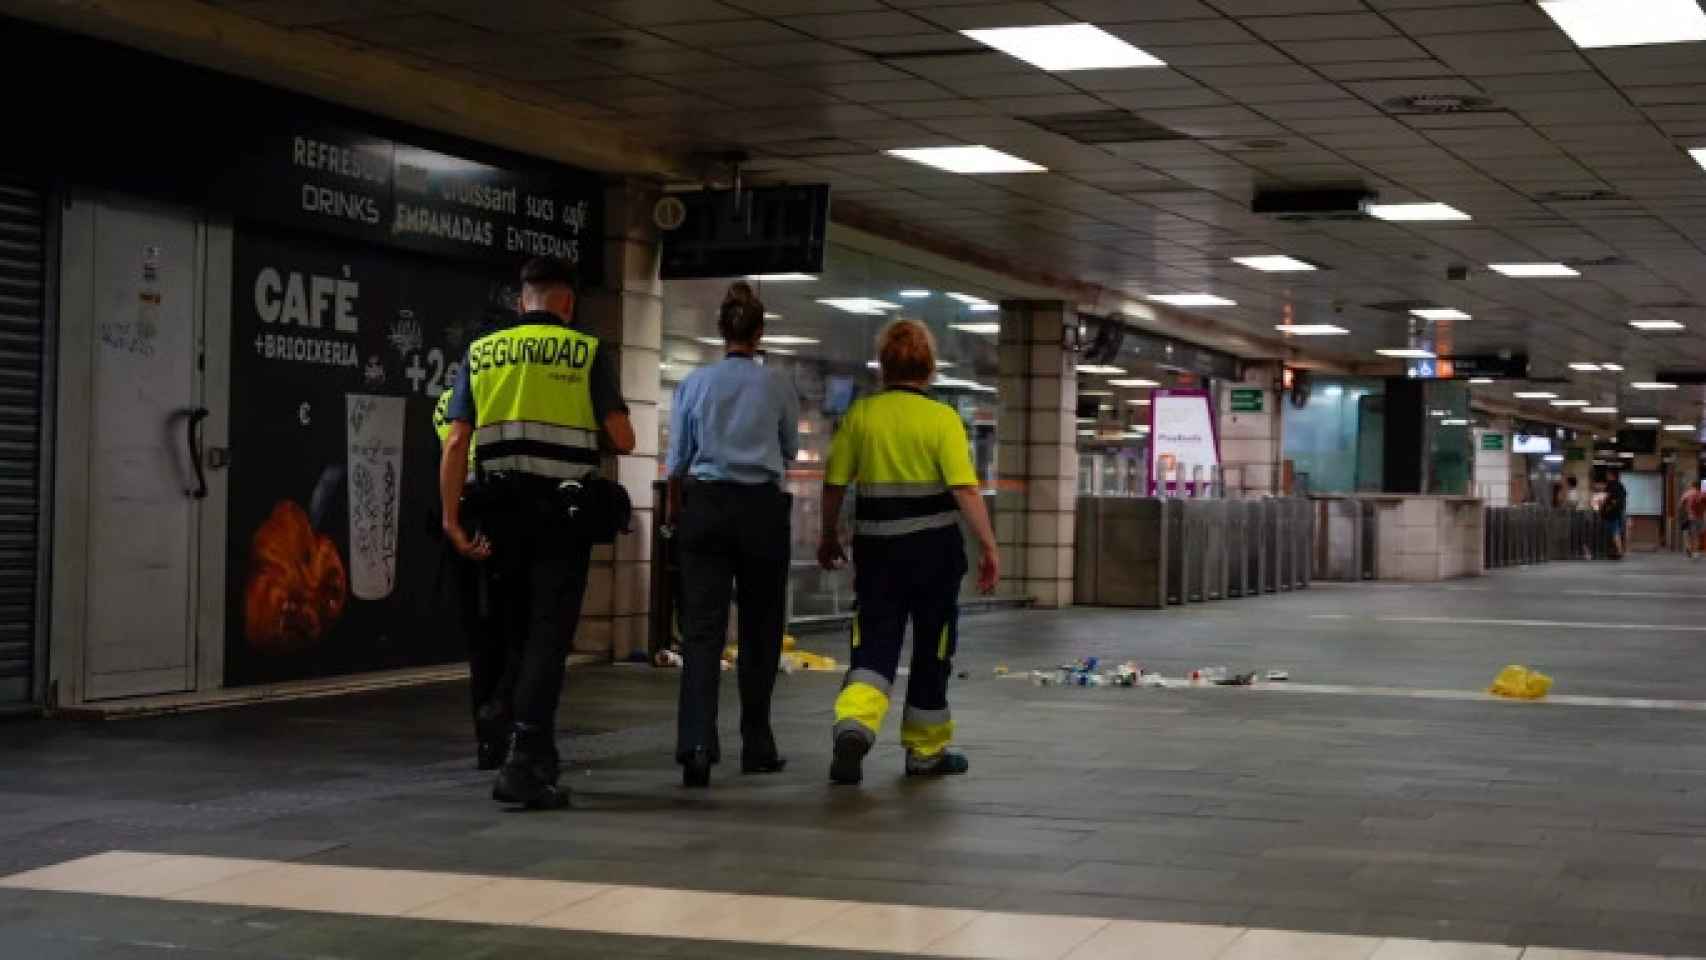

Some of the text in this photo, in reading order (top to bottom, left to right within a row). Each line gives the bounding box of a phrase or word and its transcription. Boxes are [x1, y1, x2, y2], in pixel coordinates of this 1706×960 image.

[302, 184, 380, 224] DRINKS
[396, 205, 580, 263] EMPANADAS ENTREPANS
[472, 336, 589, 376] SEGURIDAD
